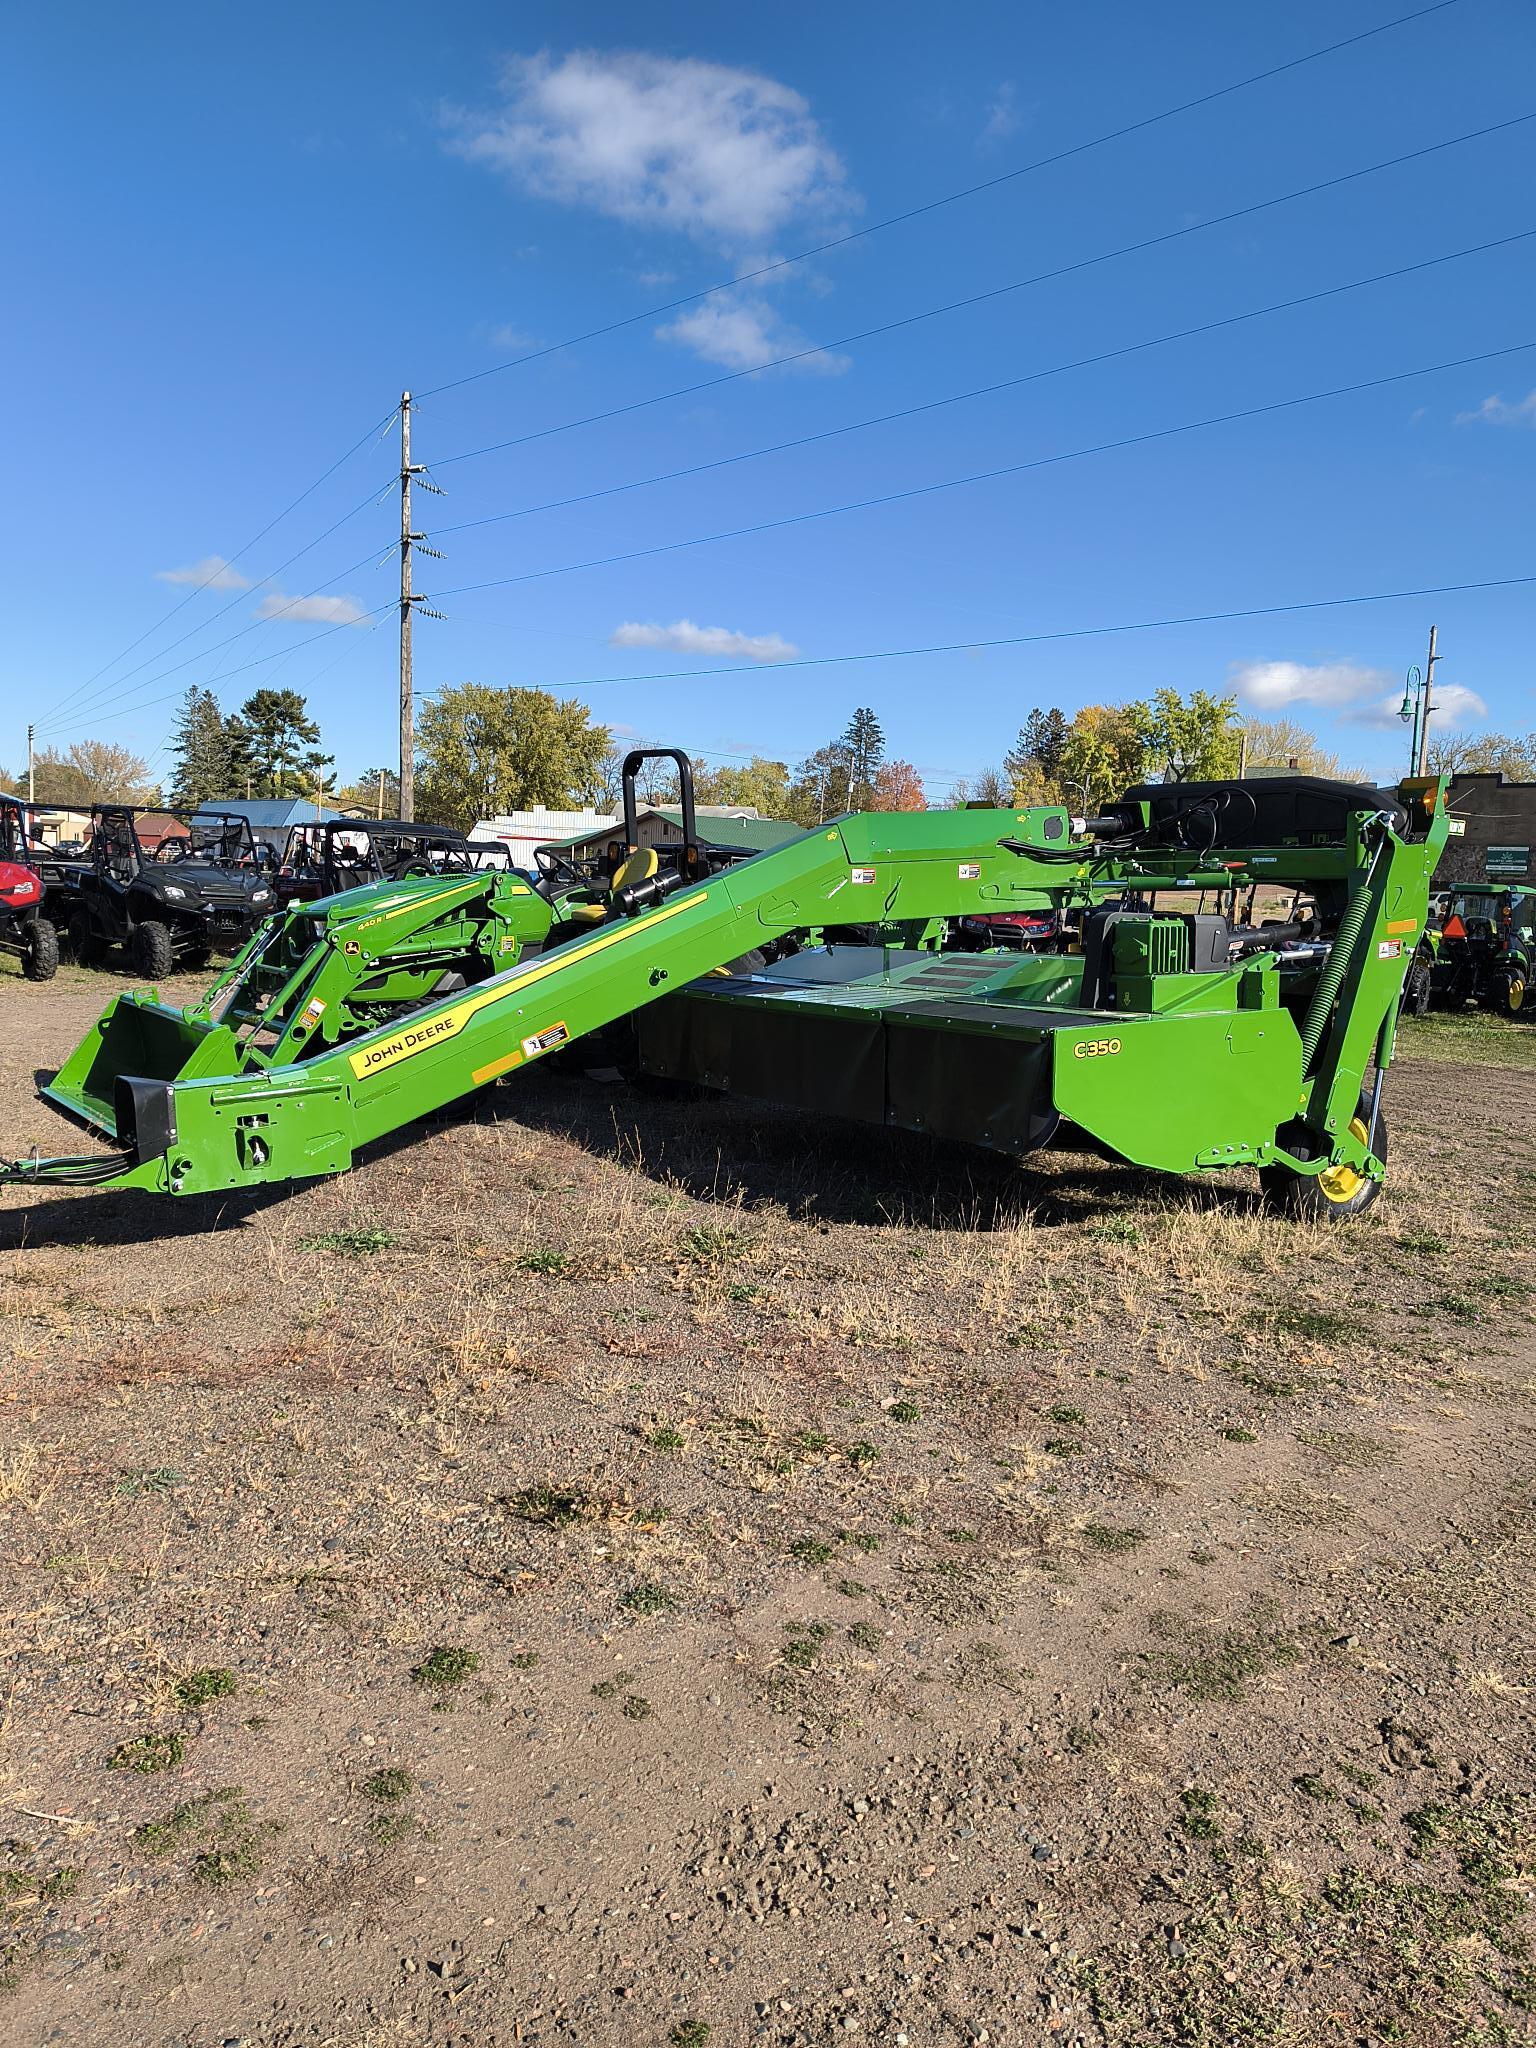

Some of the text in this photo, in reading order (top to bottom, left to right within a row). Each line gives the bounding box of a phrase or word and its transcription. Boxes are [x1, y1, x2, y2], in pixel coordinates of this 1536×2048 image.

[364, 1018, 455, 1068] JOHN DEERE
[1073, 1037, 1122, 1059] C350
